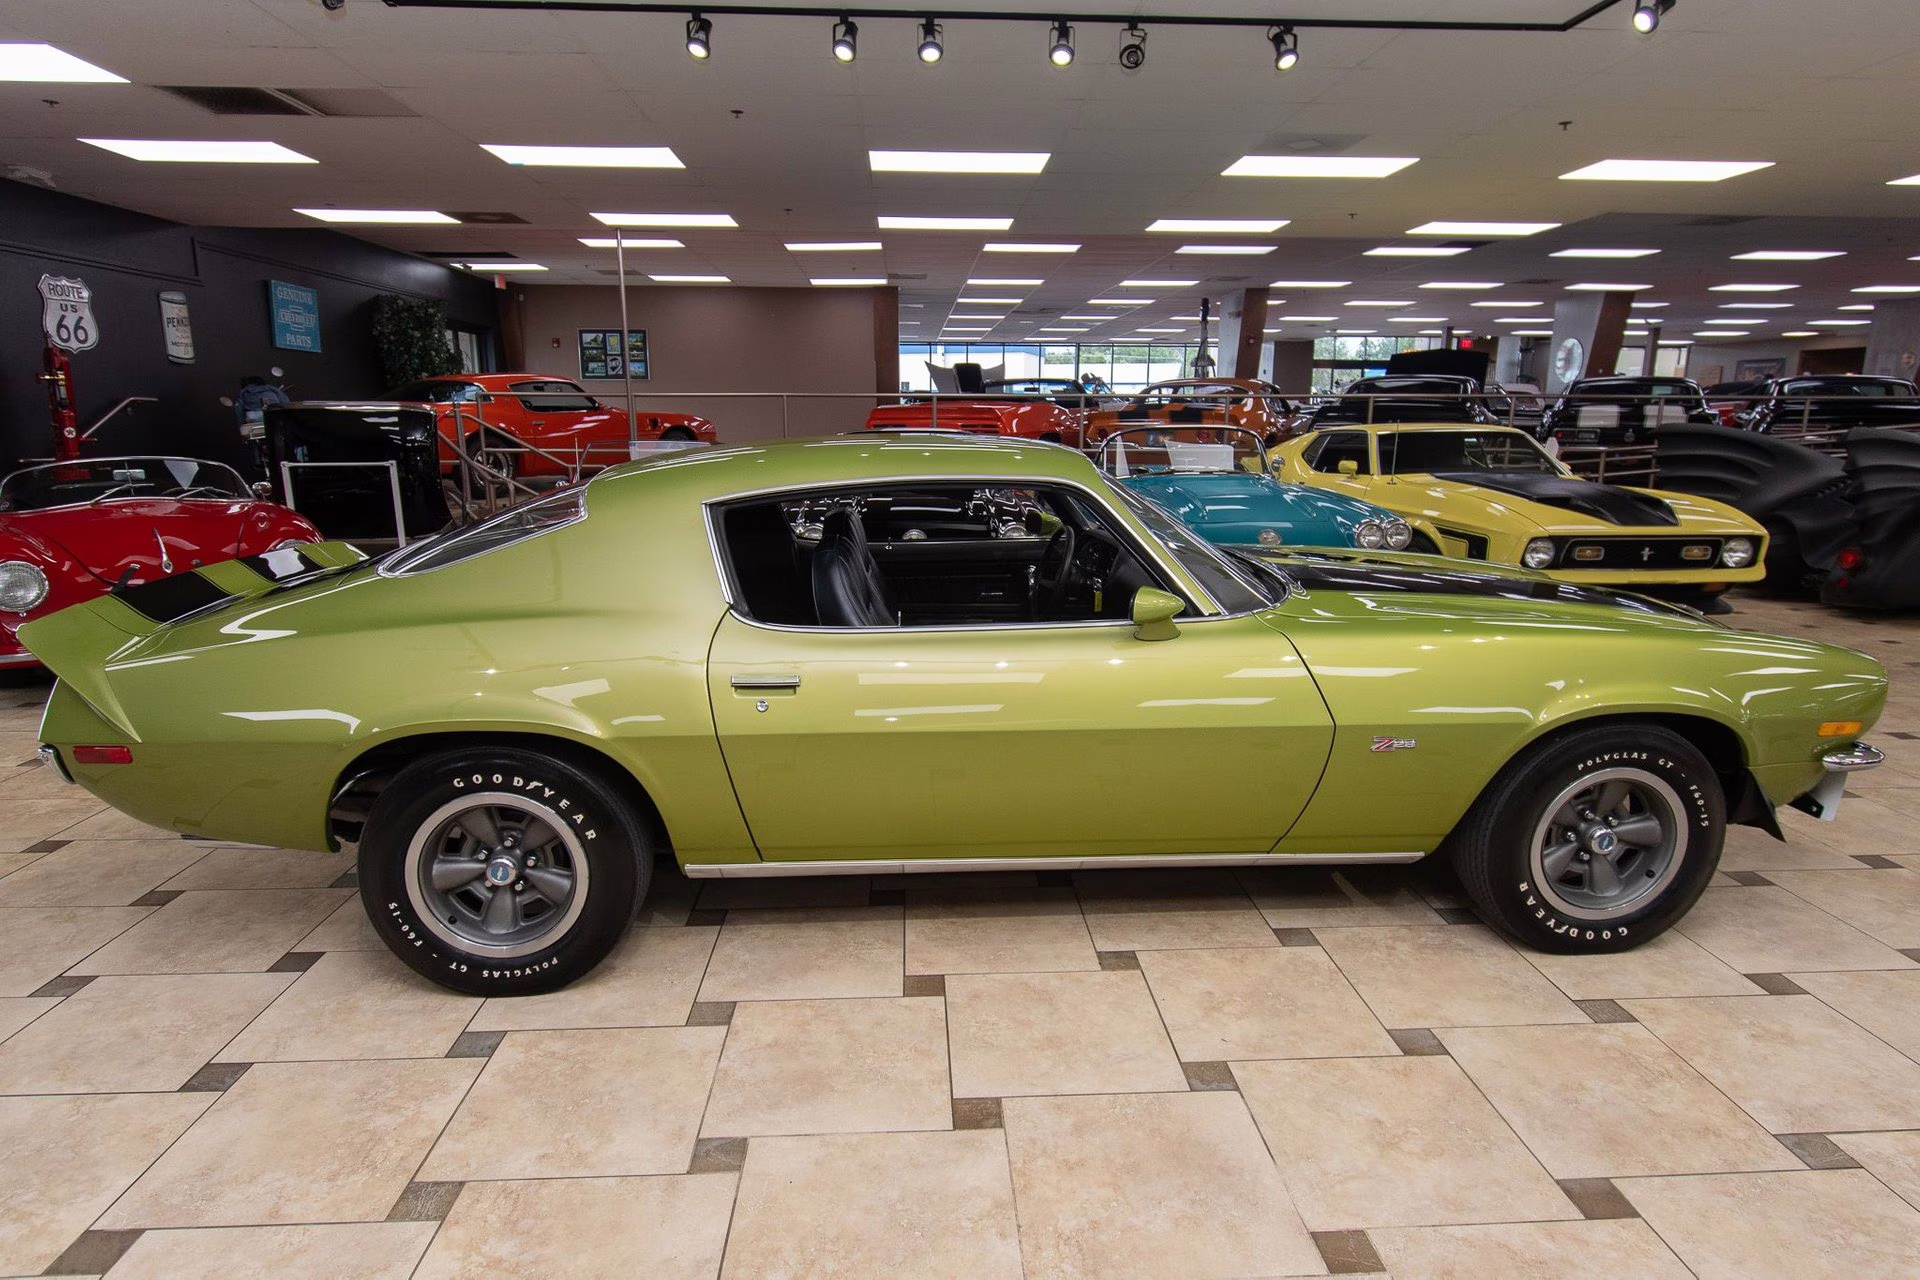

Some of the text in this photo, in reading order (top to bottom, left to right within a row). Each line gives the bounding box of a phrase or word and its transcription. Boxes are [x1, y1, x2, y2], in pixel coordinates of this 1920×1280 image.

[47, 282, 84, 299] ROUTE
[277, 286, 313, 304] GENUINE
[60, 303, 78, 313] US
[56, 314, 88, 345] 66
[286, 333, 312, 348] PARTS
[1577, 751, 1649, 771] POLYGLAS
[1658, 757, 1675, 770] GT
[1690, 784, 1709, 828] F60-15
[453, 773, 597, 841] GOODYEAR
[1519, 880, 1628, 940] GOODYEAR
[388, 901, 423, 948] F60-15
[449, 962, 468, 974] GT
[482, 956, 559, 979] POLYGLAS
